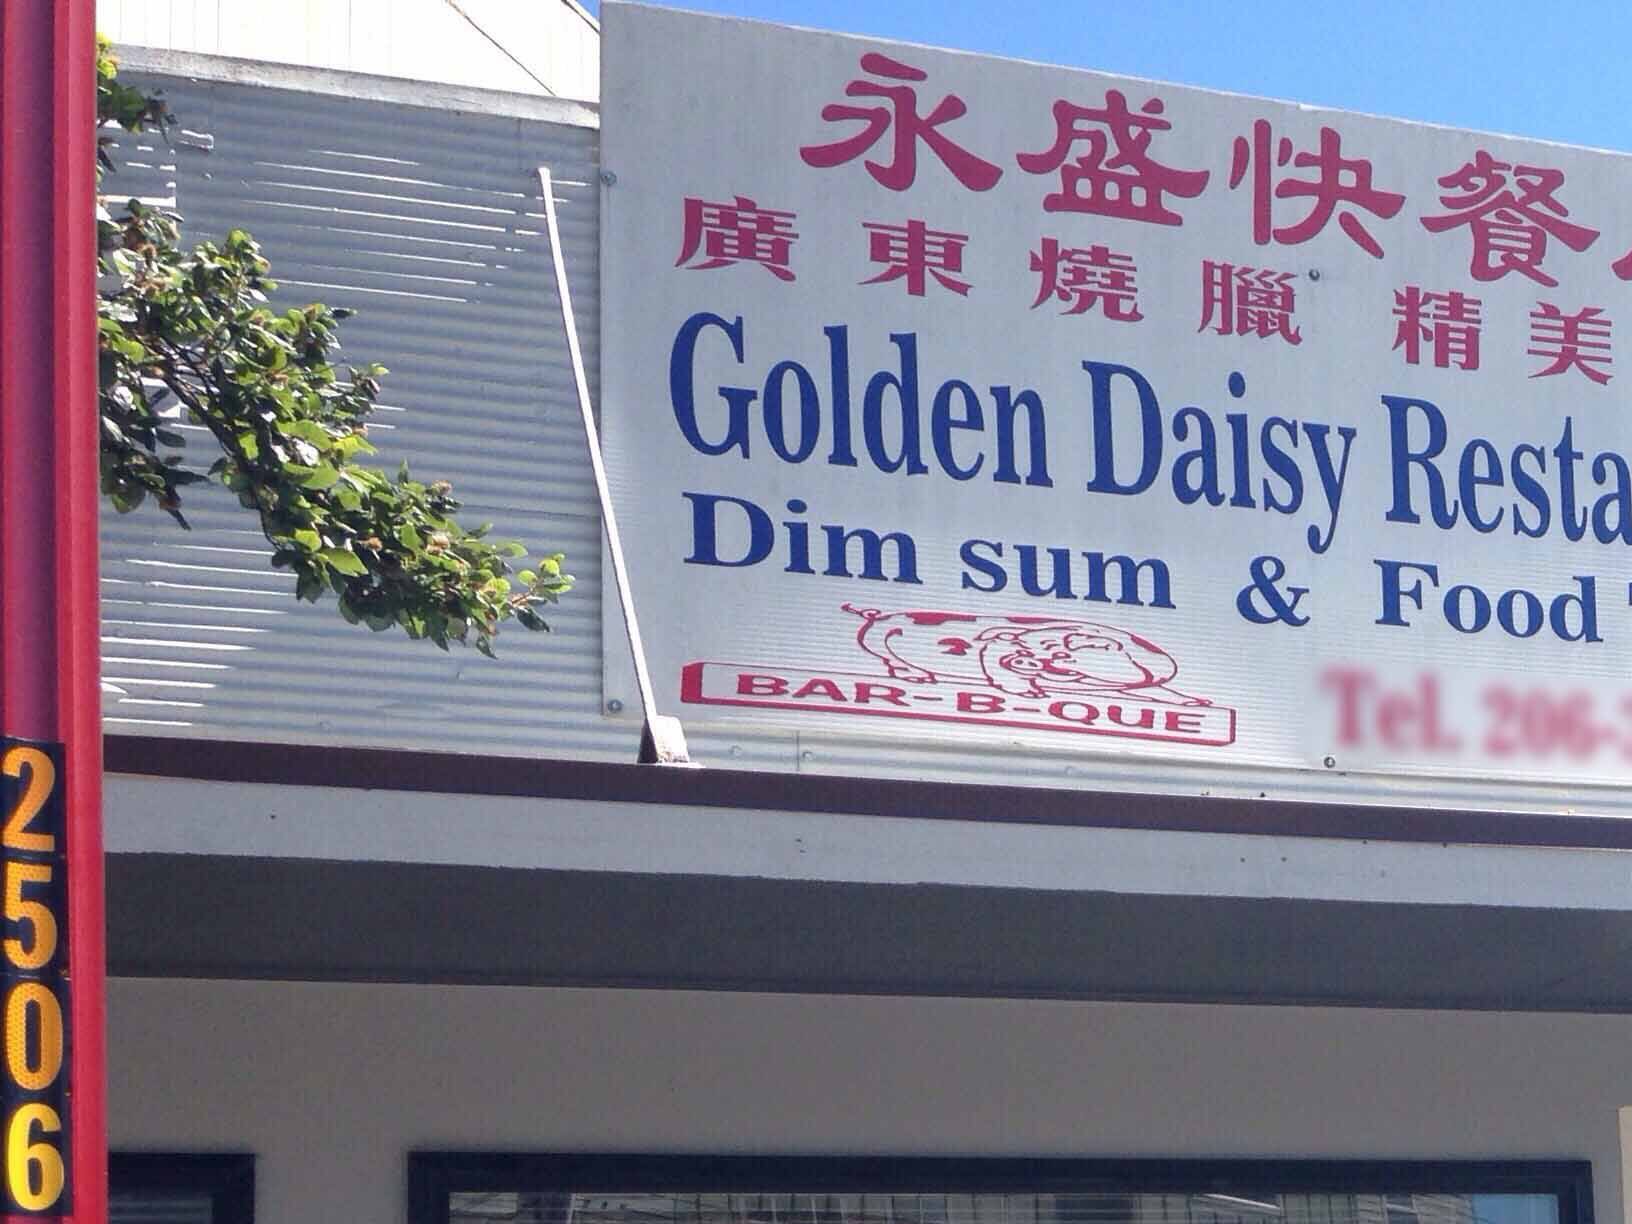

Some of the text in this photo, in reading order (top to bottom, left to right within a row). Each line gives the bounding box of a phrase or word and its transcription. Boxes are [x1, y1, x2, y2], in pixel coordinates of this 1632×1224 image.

[669, 311, 1054, 489] Golden
[1082, 359, 1357, 555] Daisy
[683, 491, 925, 586] Dim
[959, 539, 1177, 610] sum
[1236, 555, 1311, 628] &
[1373, 558, 1604, 644] Food
[735, 673, 1208, 734] BAR-B-QUE
[1, 745, 65, 1211] 2506
